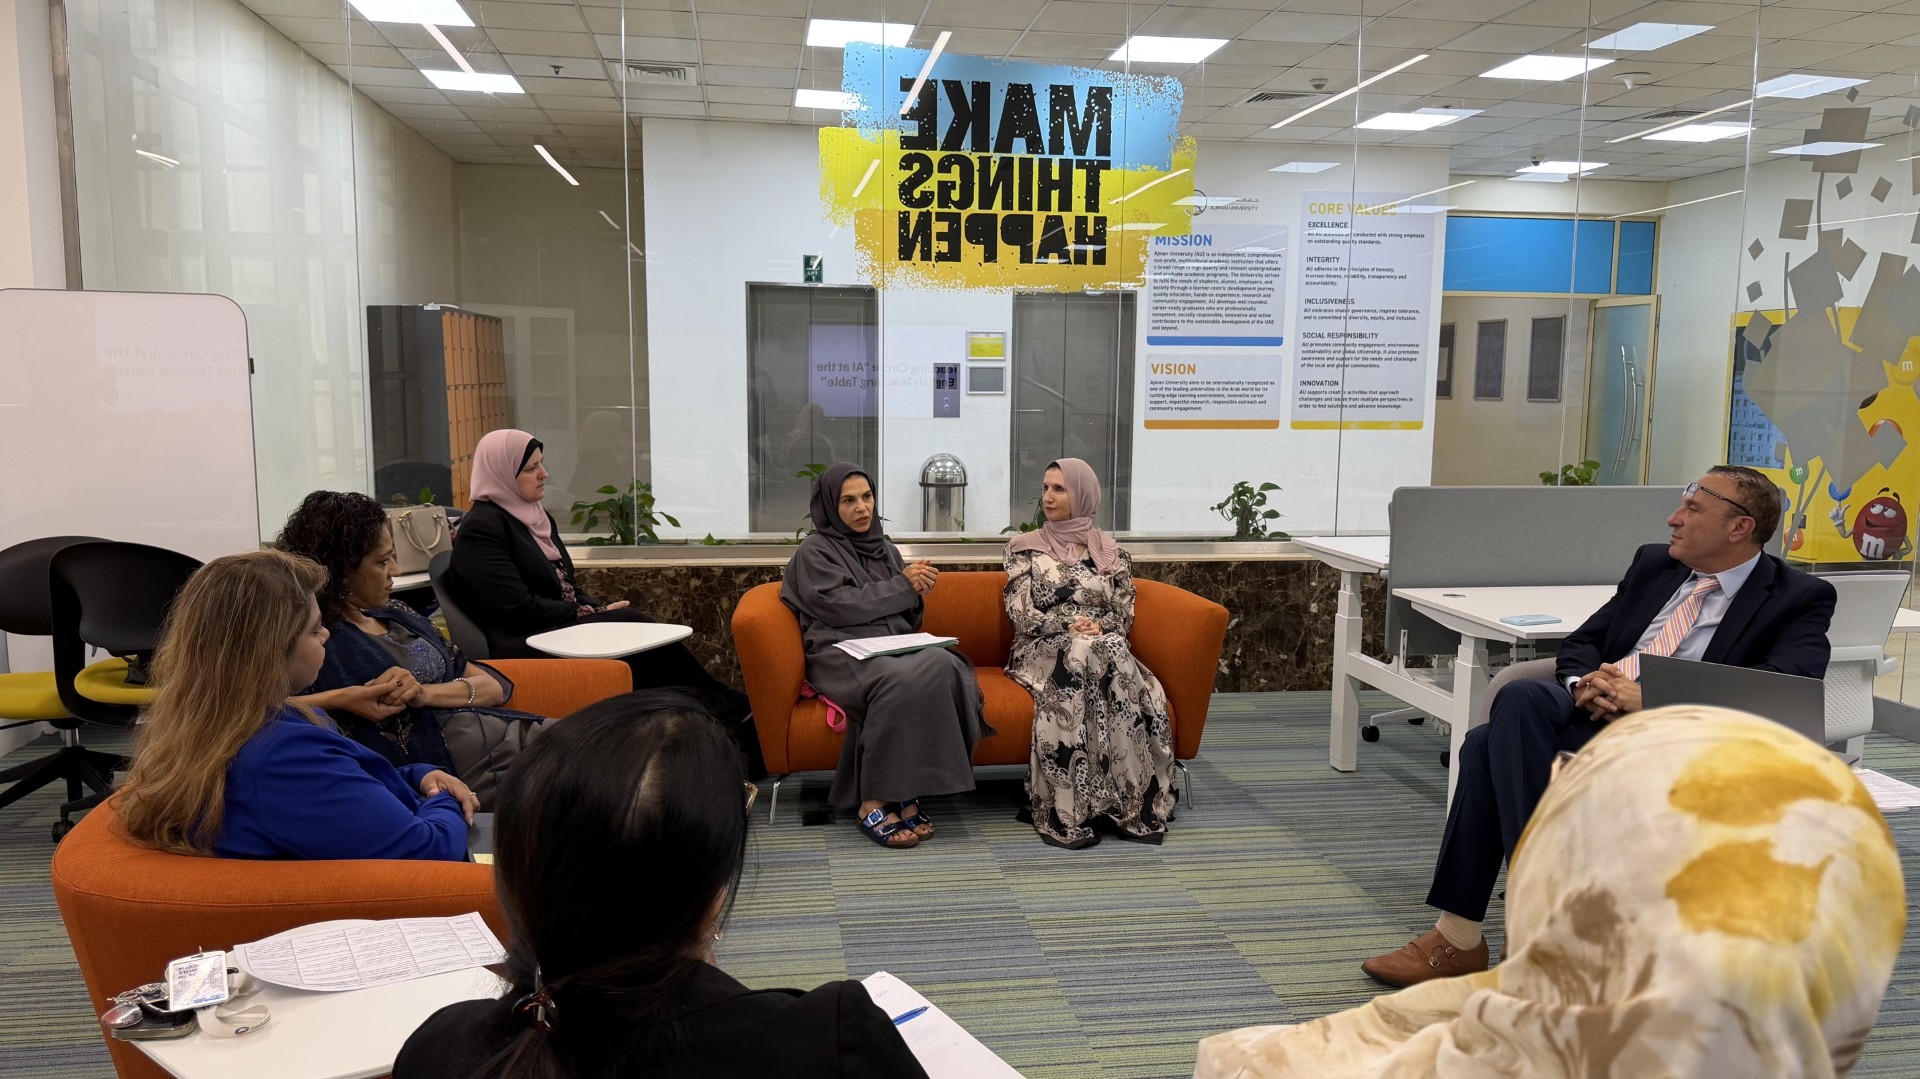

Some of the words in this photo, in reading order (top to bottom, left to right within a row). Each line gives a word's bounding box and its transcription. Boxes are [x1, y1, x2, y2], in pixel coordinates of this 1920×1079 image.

[1309, 203, 1343, 214] CORE
[1155, 234, 1212, 246] MISSION
[1151, 363, 1196, 375] VISION
[1860, 533, 1885, 559] m
